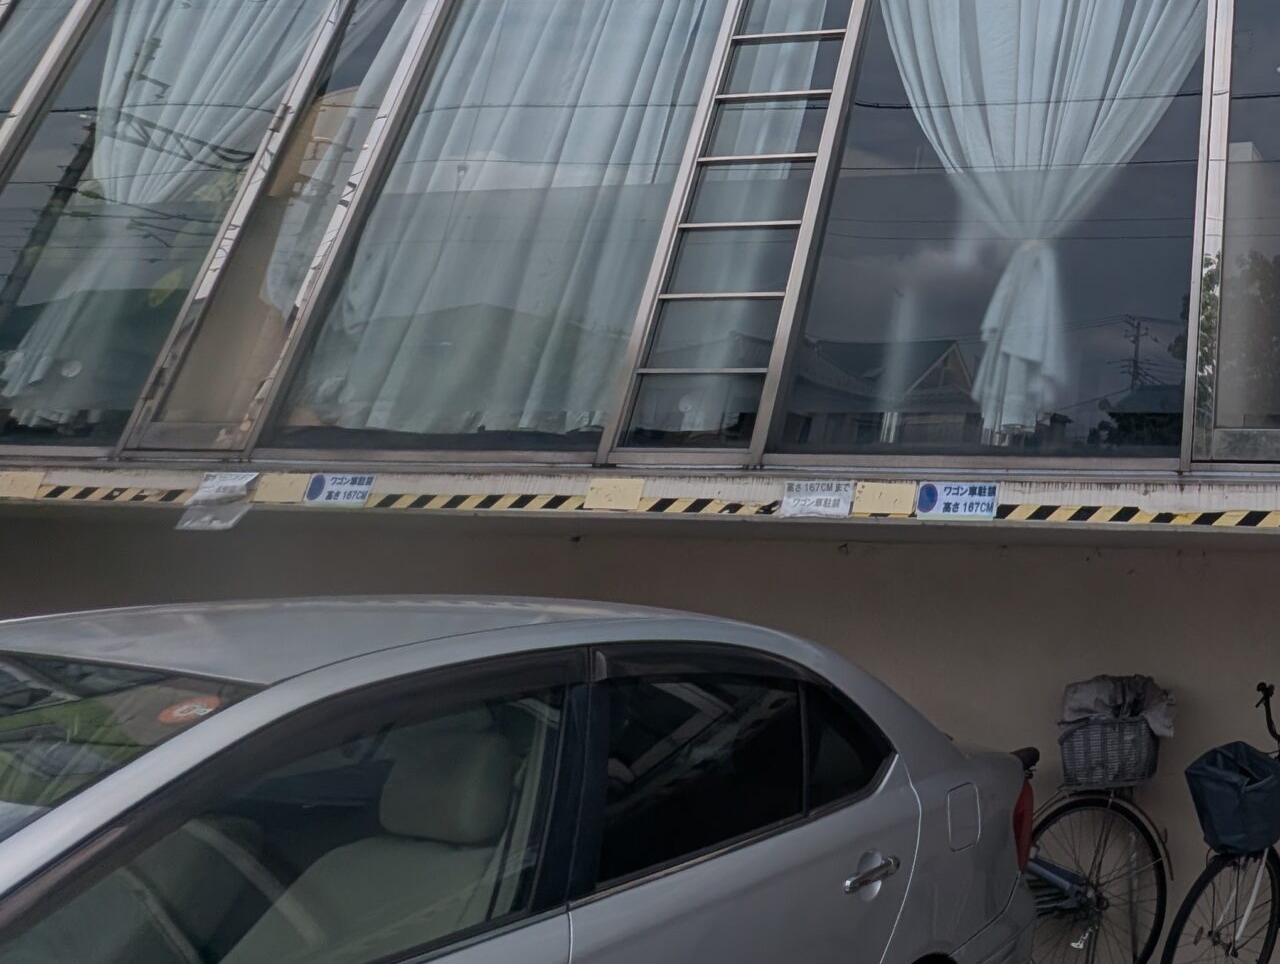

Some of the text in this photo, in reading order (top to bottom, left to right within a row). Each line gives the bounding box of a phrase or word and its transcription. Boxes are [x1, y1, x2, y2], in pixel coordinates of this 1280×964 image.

[805, 482, 833, 492] 167CM
[942, 501, 994, 513] 高さ 167CM
